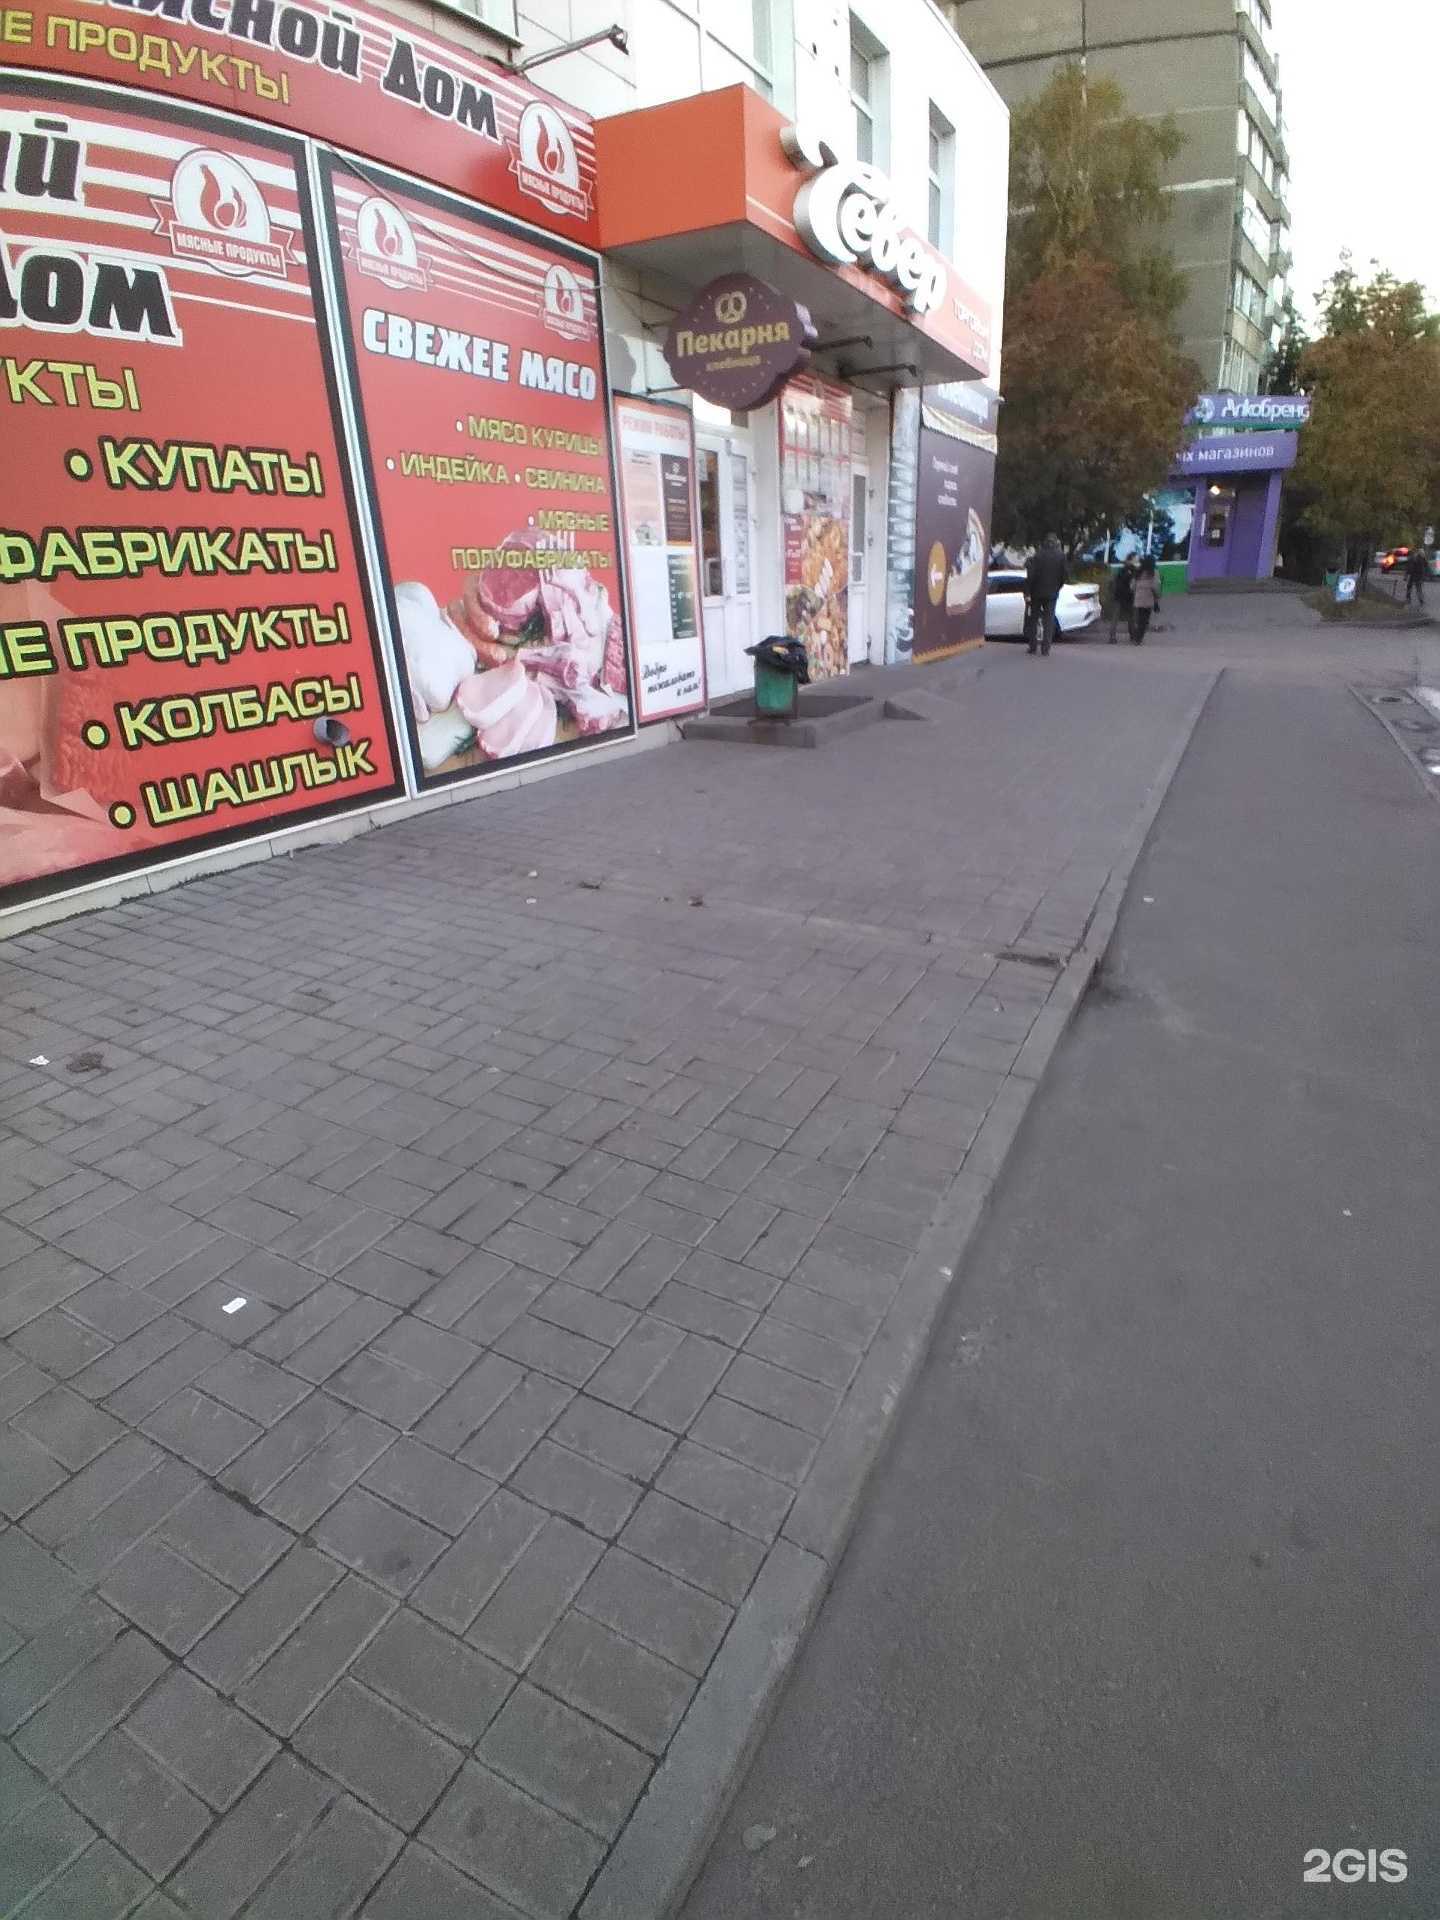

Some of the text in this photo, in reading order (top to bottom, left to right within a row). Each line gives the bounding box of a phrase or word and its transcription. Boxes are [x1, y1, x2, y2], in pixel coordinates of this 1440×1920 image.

[0, 9, 291, 105] Е ПРОДУКТЫ
[110, 0, 502, 144] СНОЙ ДОМ
[176, 231, 282, 269] МЯСНЫЕ ПРОДУКТЫ
[362, 307, 598, 401] СВЕЖЕЕ МЯСО
[676, 321, 791, 358] Пекарня
[0, 357, 142, 412] КТЫ
[467, 414, 528, 446] МЯСО
[531, 424, 604, 456] КУРИЦЫ
[1198, 446, 1275, 462] магазинов
[101, 439, 326, 497] КУПАТЫ
[400, 452, 606, 494] ИНДЕЙКА СВИНИНА
[537, 508, 610, 532] МЯСНЫЕ
[451, 547, 612, 570] ПОЛУФАБРИКАТЫ
[0, 605, 351, 676] Е ПРОДУКТЫ
[118, 675, 363, 748] КОЛБАСЫ
[144, 740, 377, 827] ШАШЛЫК
